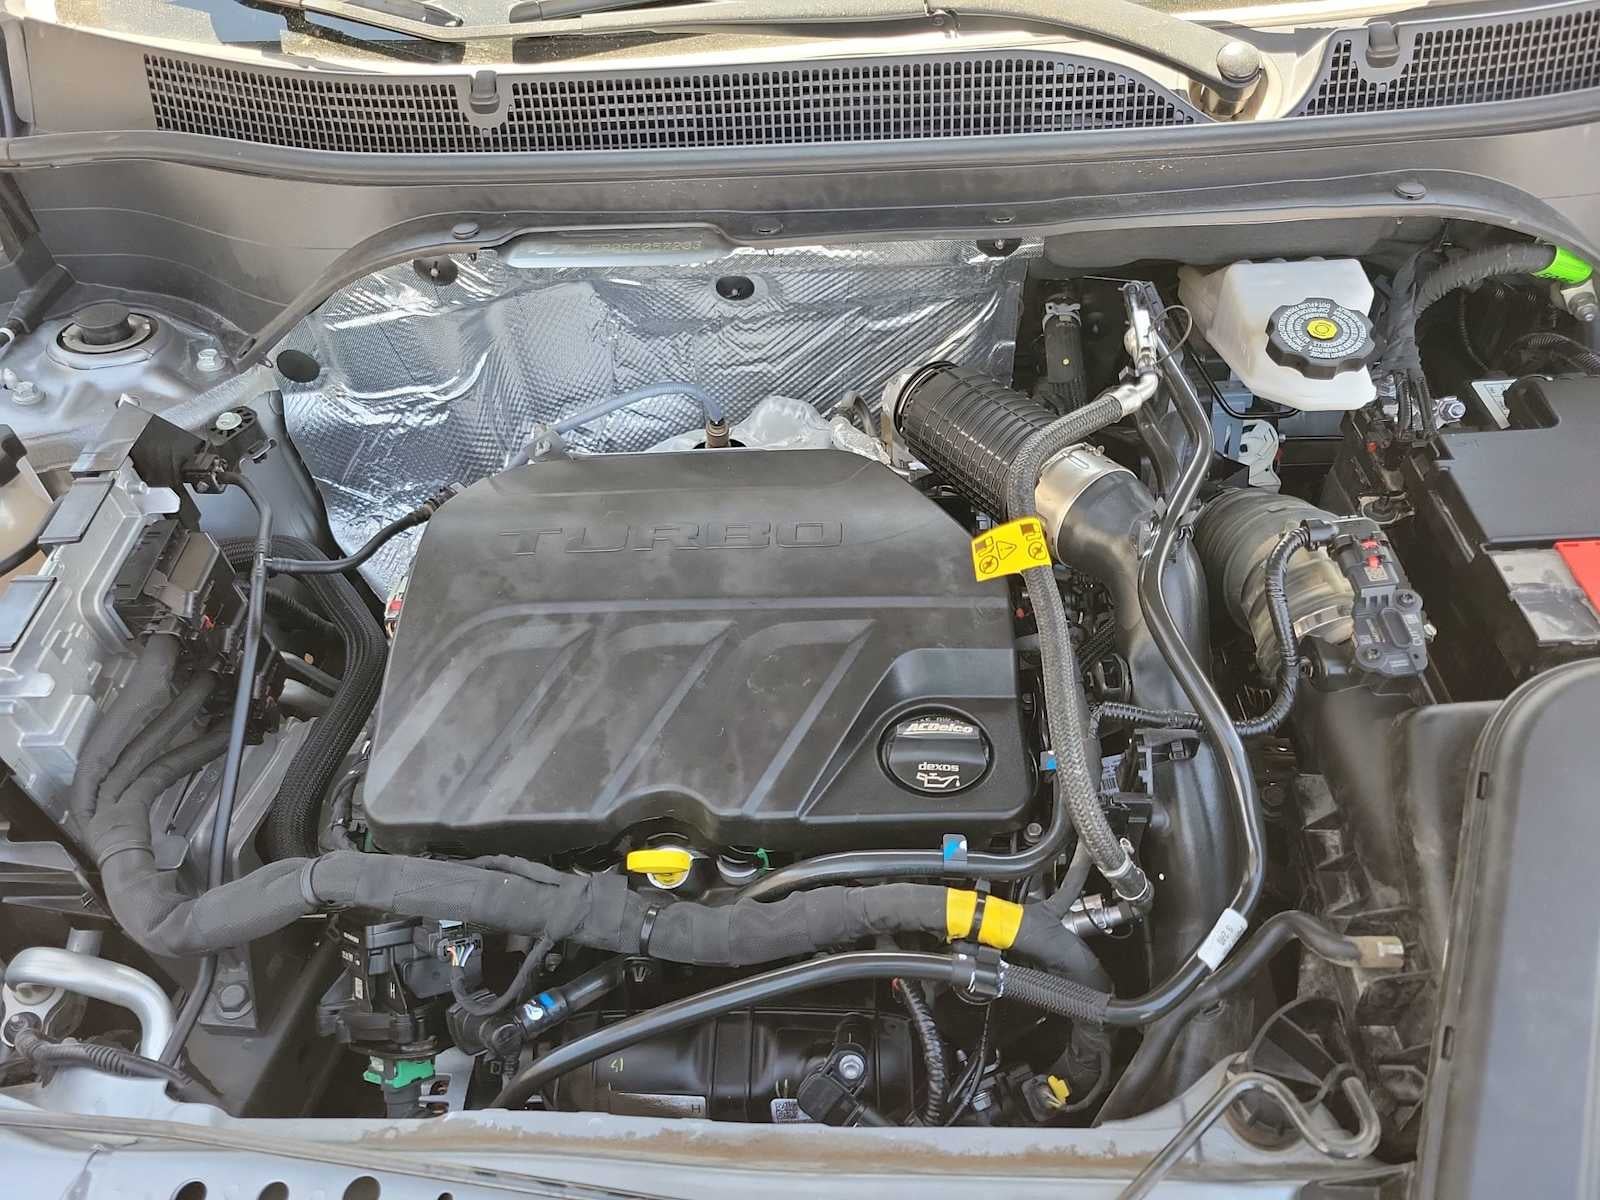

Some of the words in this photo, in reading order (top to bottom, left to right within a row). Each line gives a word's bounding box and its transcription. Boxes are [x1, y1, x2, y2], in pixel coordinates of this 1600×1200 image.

[498, 519, 847, 556] TURBO
[906, 722, 974, 734] ACDelco
[918, 761, 960, 772] dexos
